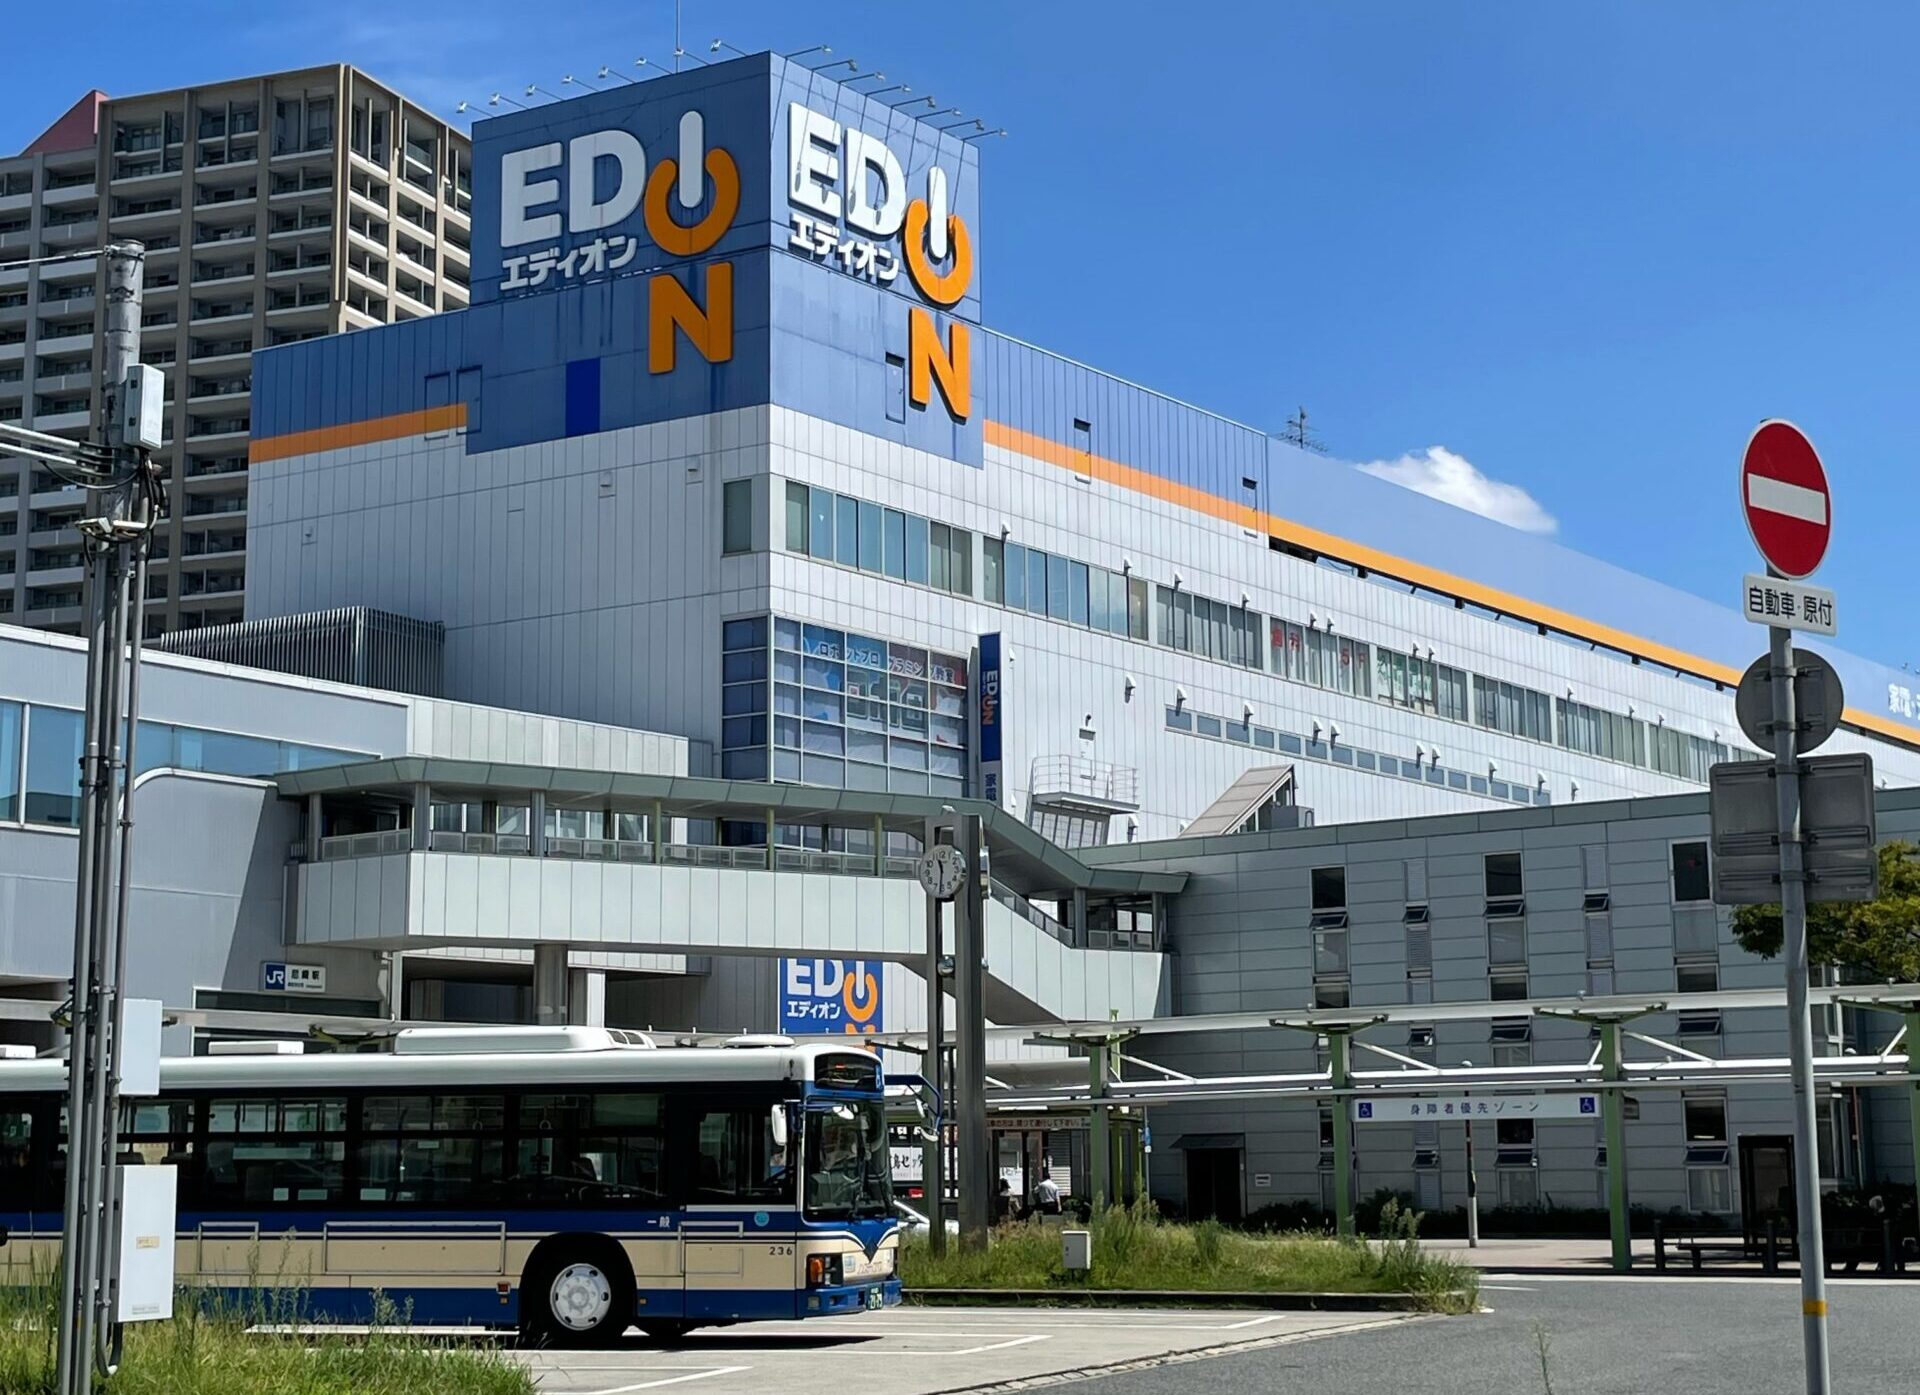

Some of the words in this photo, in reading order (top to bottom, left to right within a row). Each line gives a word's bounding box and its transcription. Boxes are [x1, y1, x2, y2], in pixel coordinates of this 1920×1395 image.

[788, 213, 900, 282] エディオン
[500, 236, 638, 290] エディオン
[1749, 585, 1832, 626] 自動車・原付
[266, 970, 284, 984] JR
[787, 1001, 840, 1019] エディオン
[1410, 1101, 1540, 1116] 身障者優先ゾーン
[769, 1246, 793, 1256] 236
